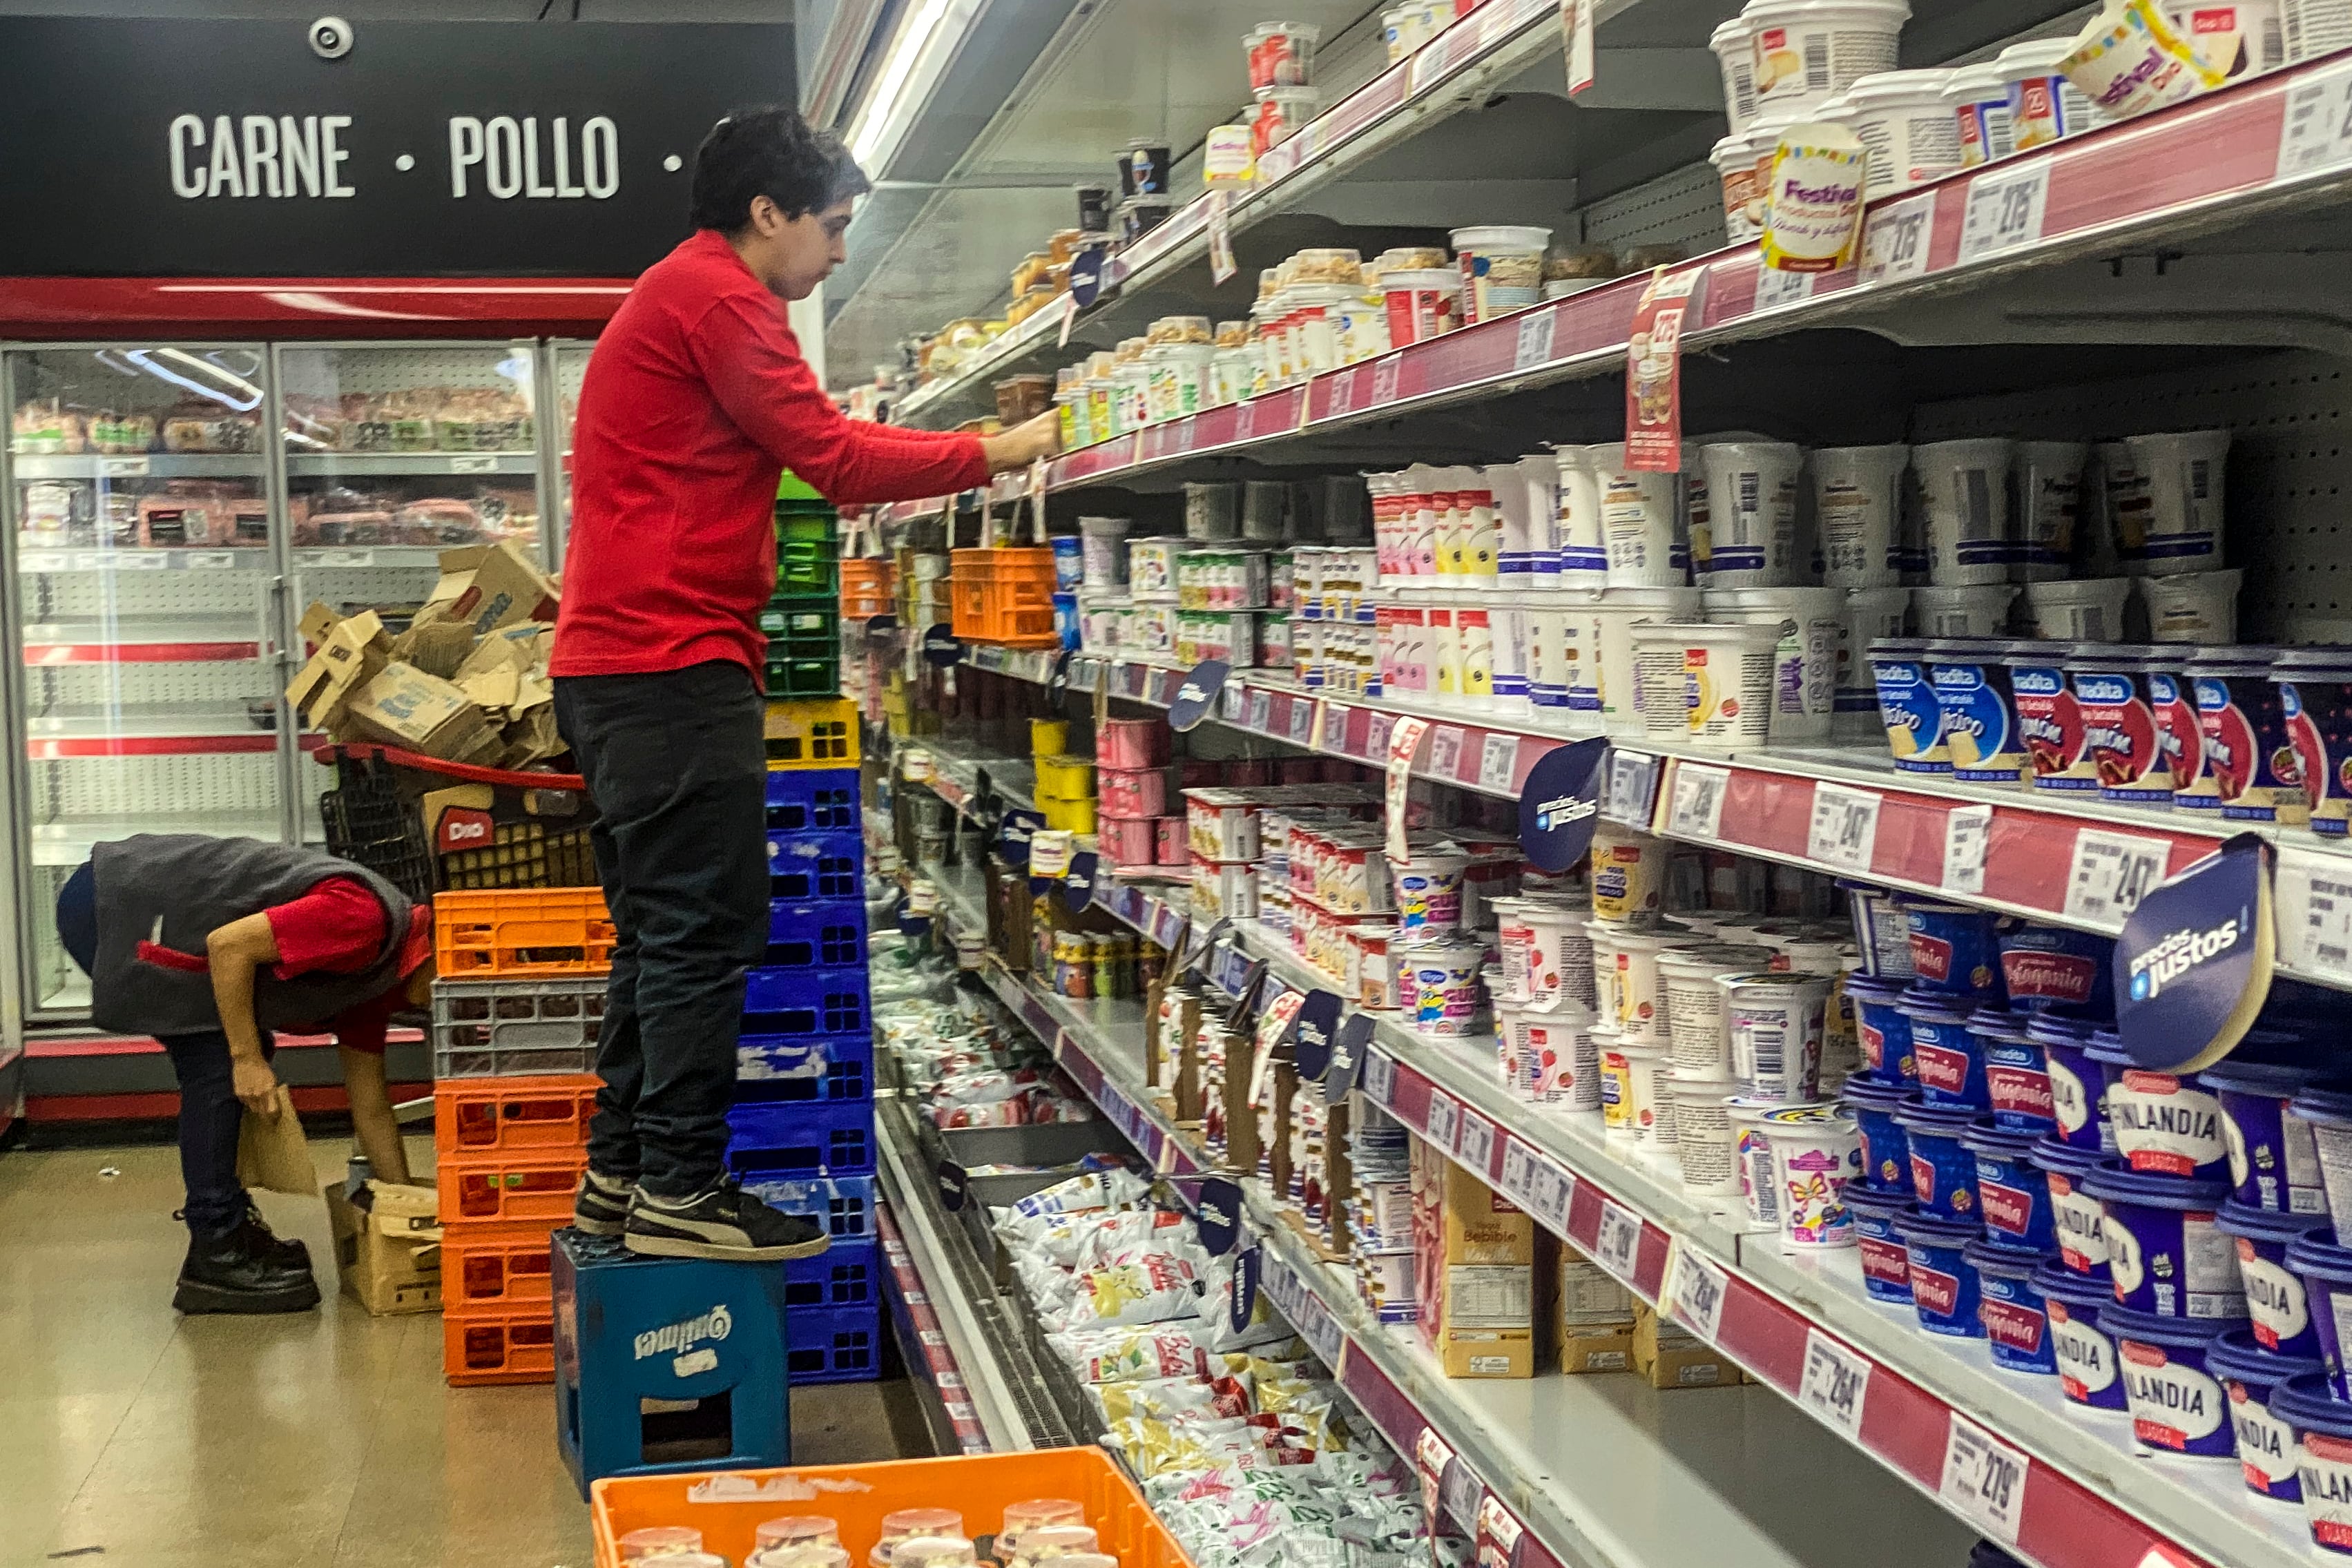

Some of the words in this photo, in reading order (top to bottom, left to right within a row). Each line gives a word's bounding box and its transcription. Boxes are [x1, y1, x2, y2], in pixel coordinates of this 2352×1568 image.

[169, 114, 355, 199] CARNE
[450, 115, 620, 199] POLLO
[449, 822, 485, 841] Dia
[2130, 927, 2192, 978] precios
[2148, 919, 2238, 999] justos
[1463, 1229, 1518, 1243] Bebible
[635, 1304, 732, 1360] Quilmes
